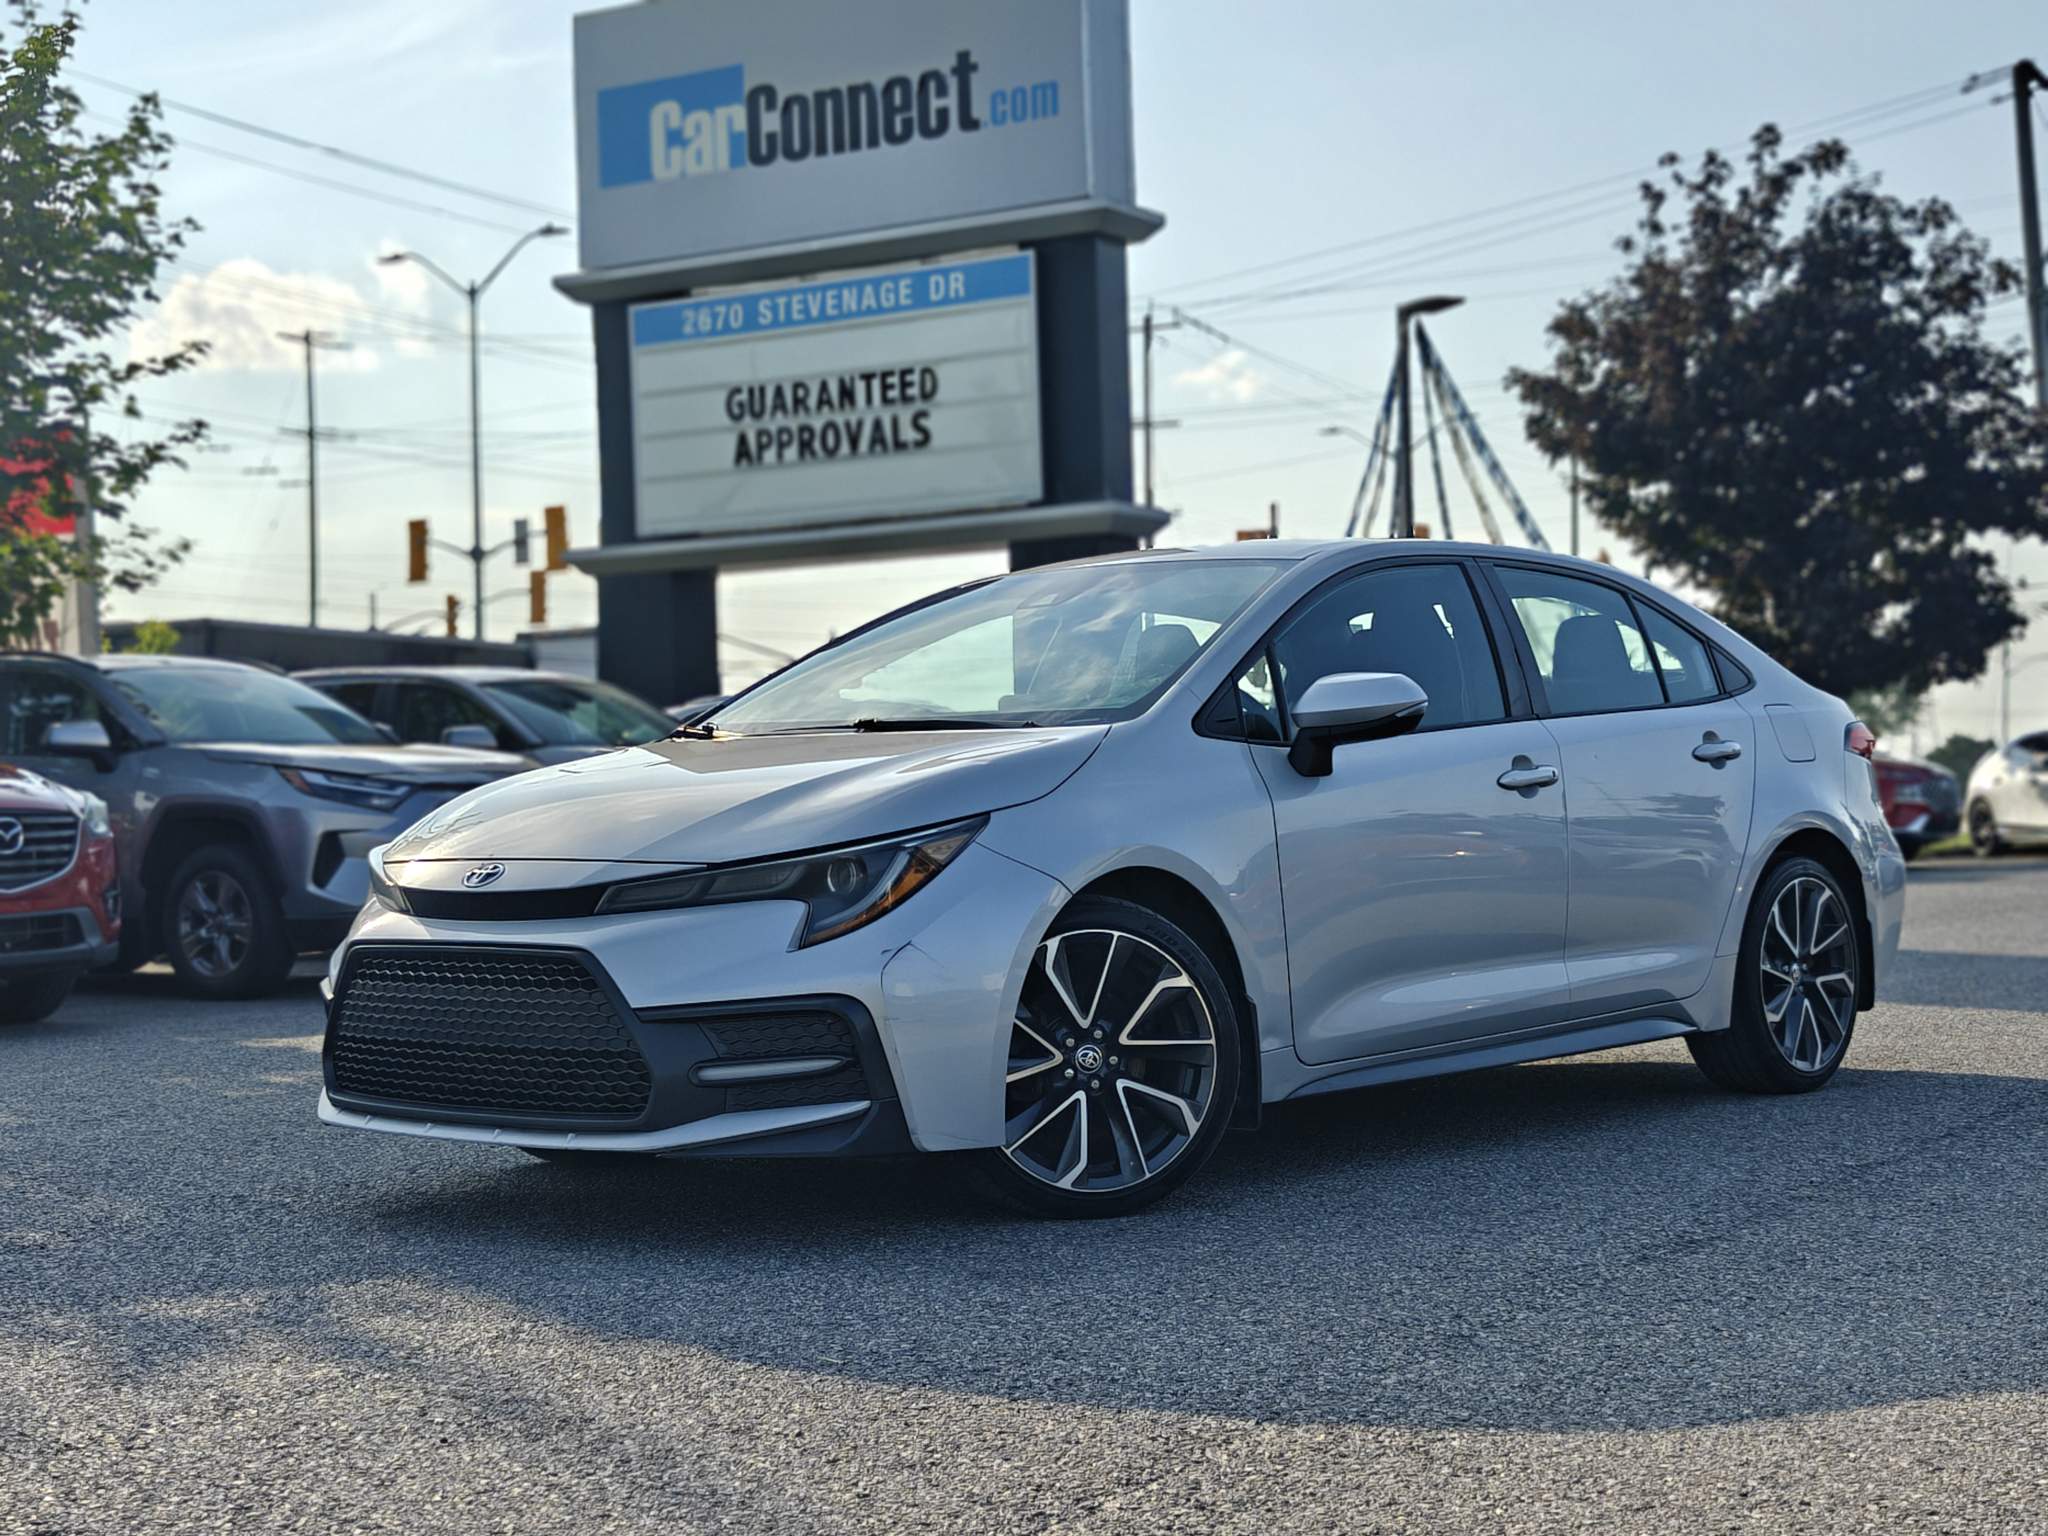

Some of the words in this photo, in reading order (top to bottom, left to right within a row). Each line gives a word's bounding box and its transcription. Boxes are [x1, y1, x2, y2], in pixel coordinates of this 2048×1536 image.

[681, 304, 744, 335] 2670
[757, 278, 913, 325] STEVENAGE
[929, 271, 967, 302] DR
[725, 367, 939, 422] GUARANTEED
[733, 410, 932, 467] APPROVALS
